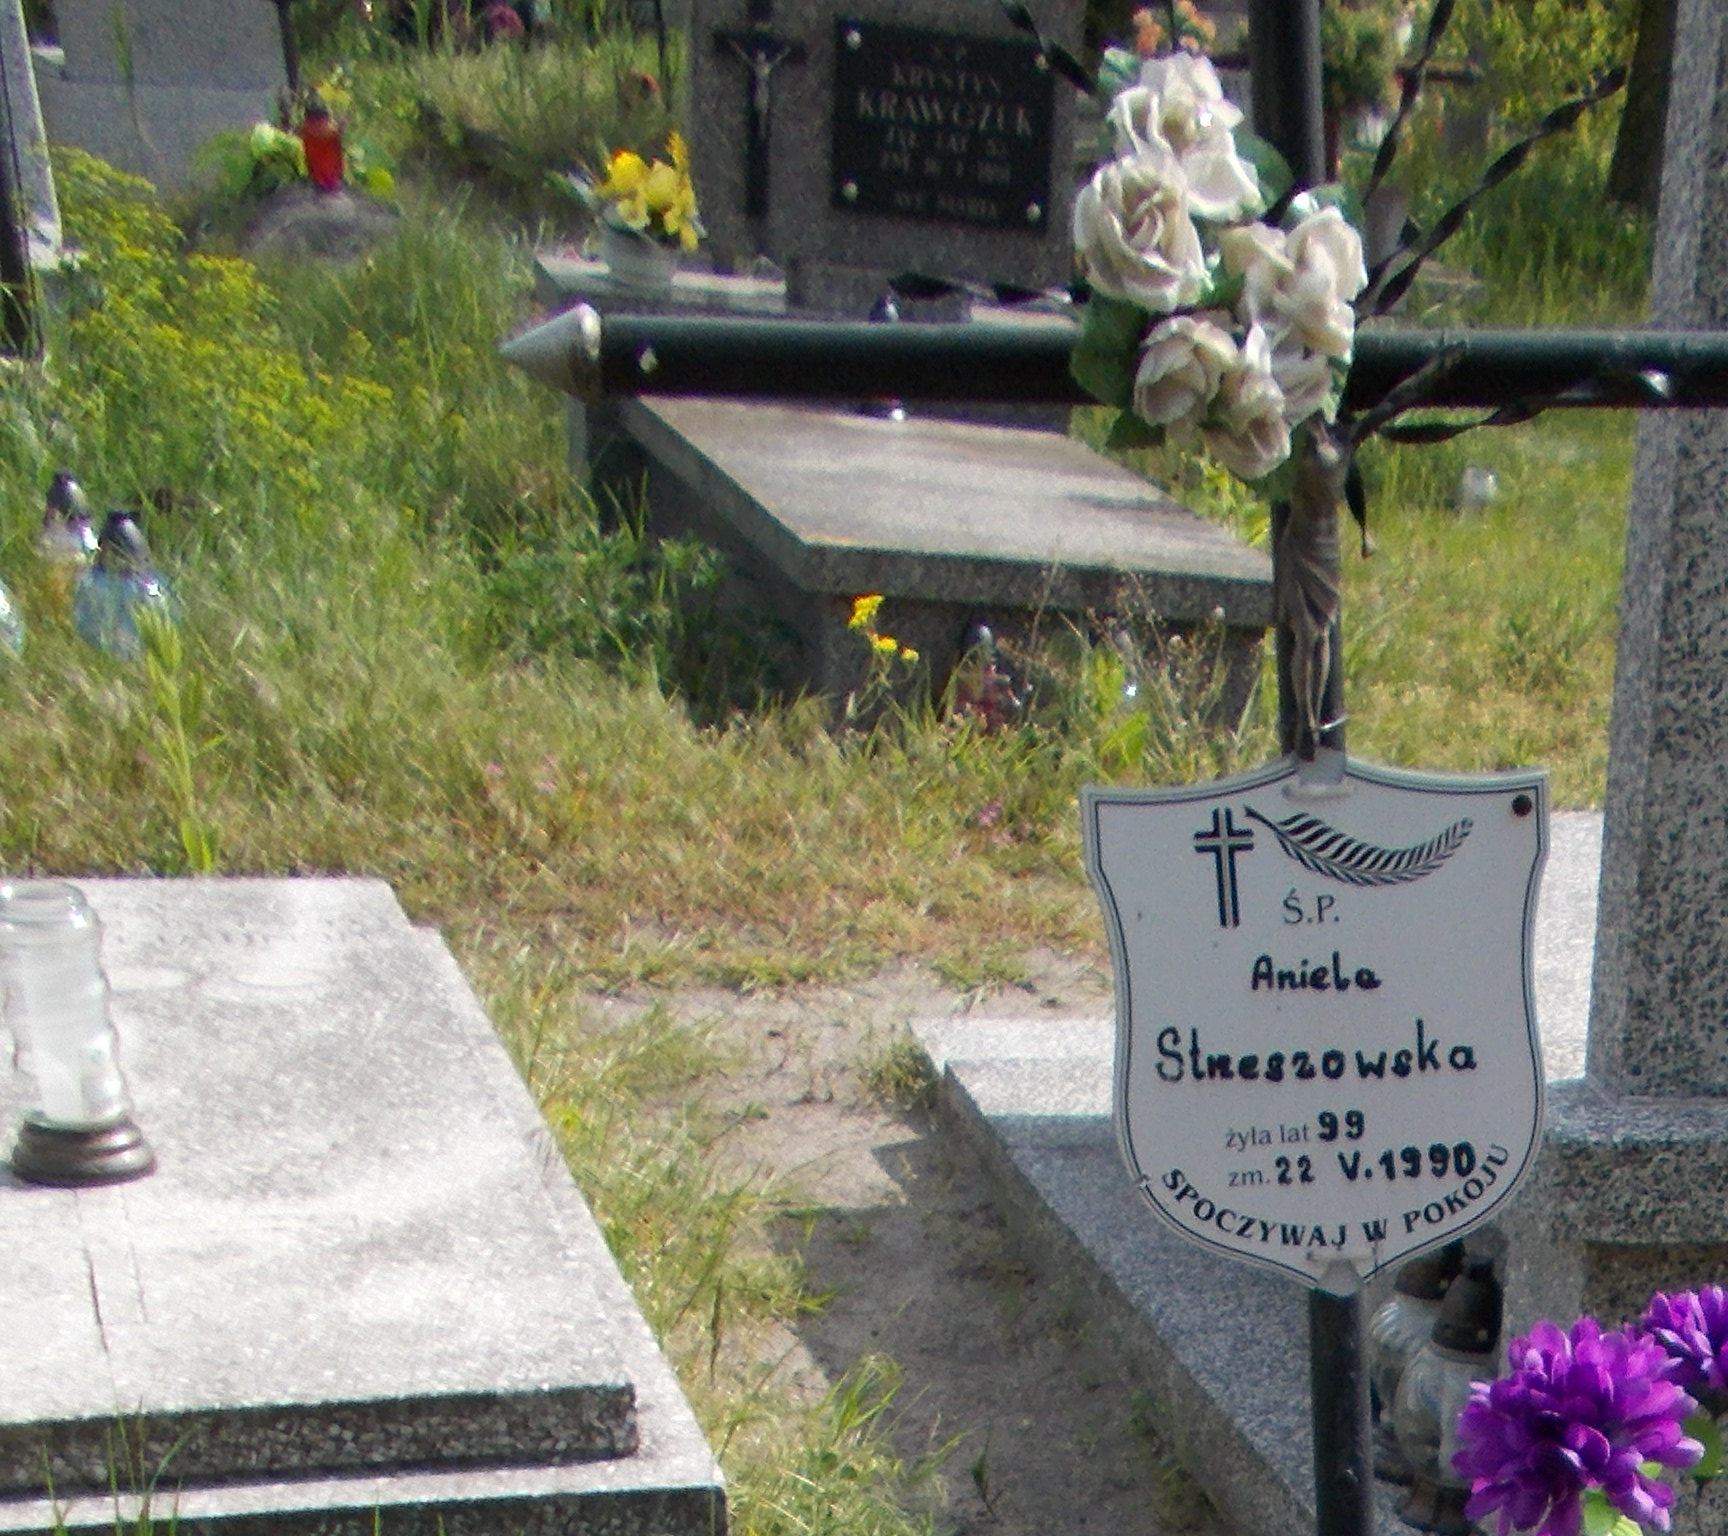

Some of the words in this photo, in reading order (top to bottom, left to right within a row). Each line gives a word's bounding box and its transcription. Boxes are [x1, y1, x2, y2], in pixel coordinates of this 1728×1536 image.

[1283, 887, 1340, 924] Ś.P.
[1251, 950, 1383, 991] Aniela
[1279, 1123, 1309, 1144] lat
[1318, 1109, 1366, 1142] 99
[1228, 1168, 1271, 1187] zm.
[1275, 1153, 1316, 1185] 22
[1162, 1168, 1347, 1248] SPOCZYWAJ
[1361, 1218, 1388, 1242] W
[1402, 1143, 1509, 1234] POKOJU
